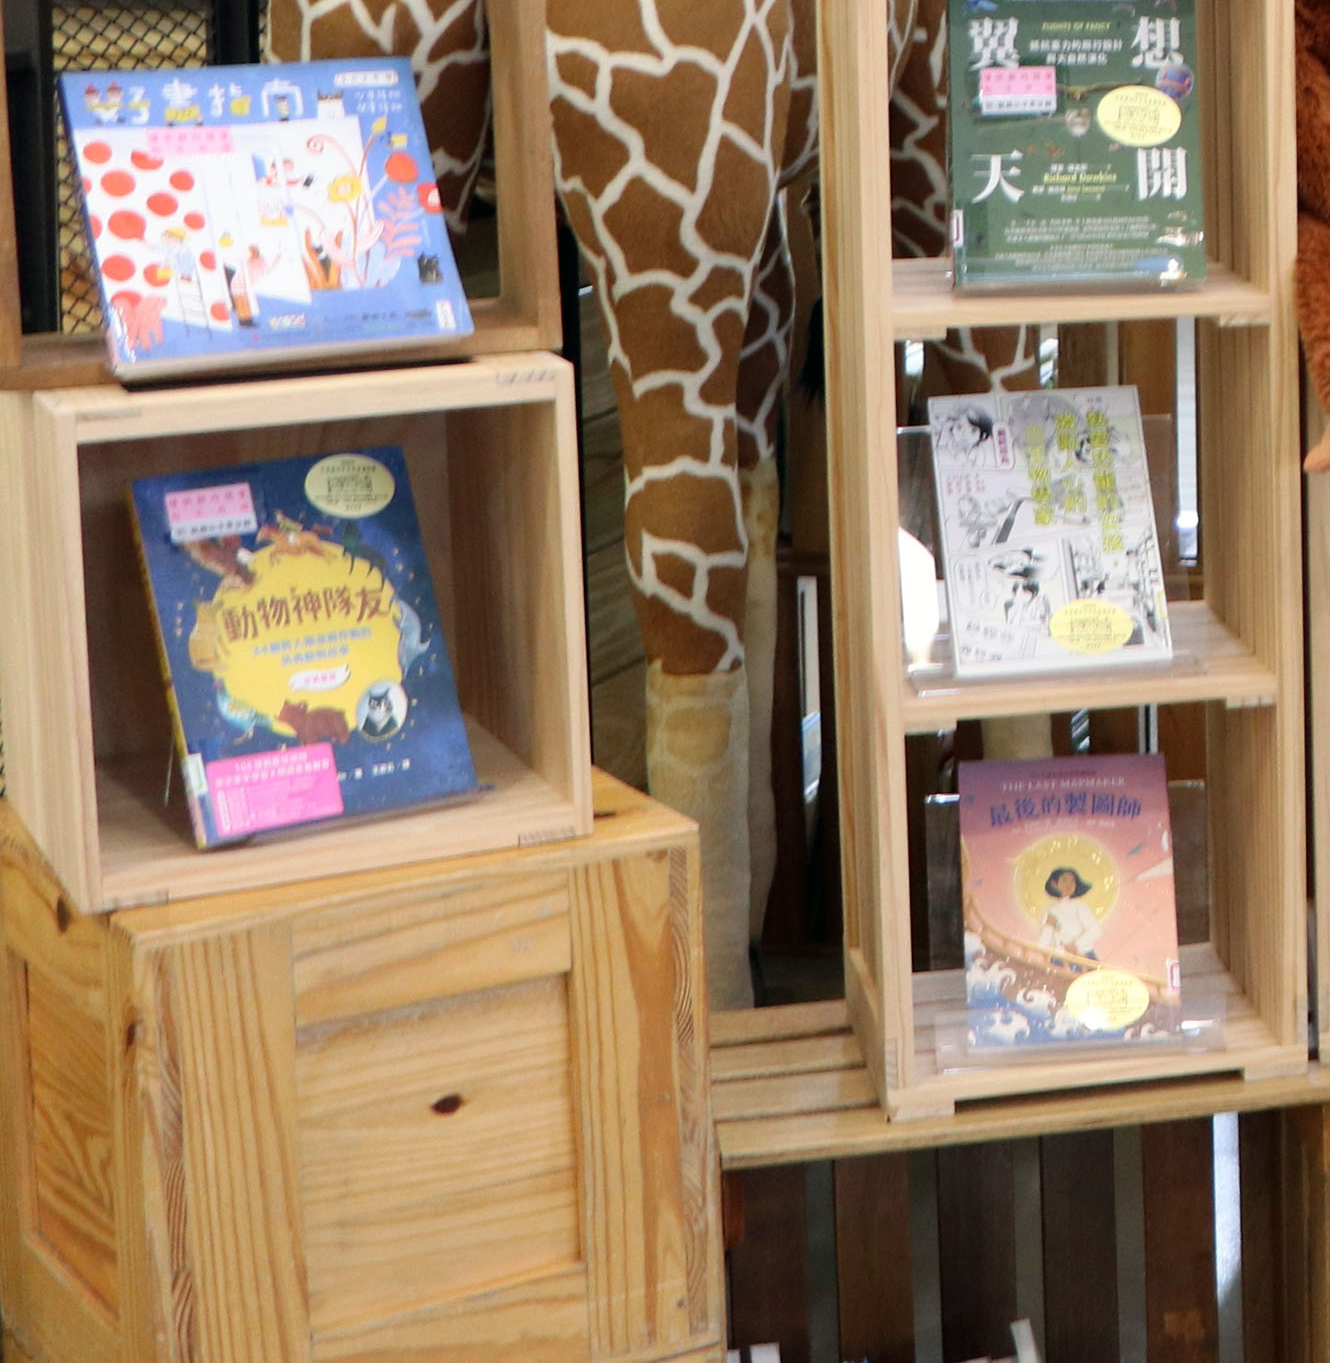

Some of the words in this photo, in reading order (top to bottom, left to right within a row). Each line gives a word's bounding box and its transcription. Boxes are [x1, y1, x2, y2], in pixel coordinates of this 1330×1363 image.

[221, 585, 391, 644] 動物神隊友
[989, 790, 1142, 827] 最後的製圖師
